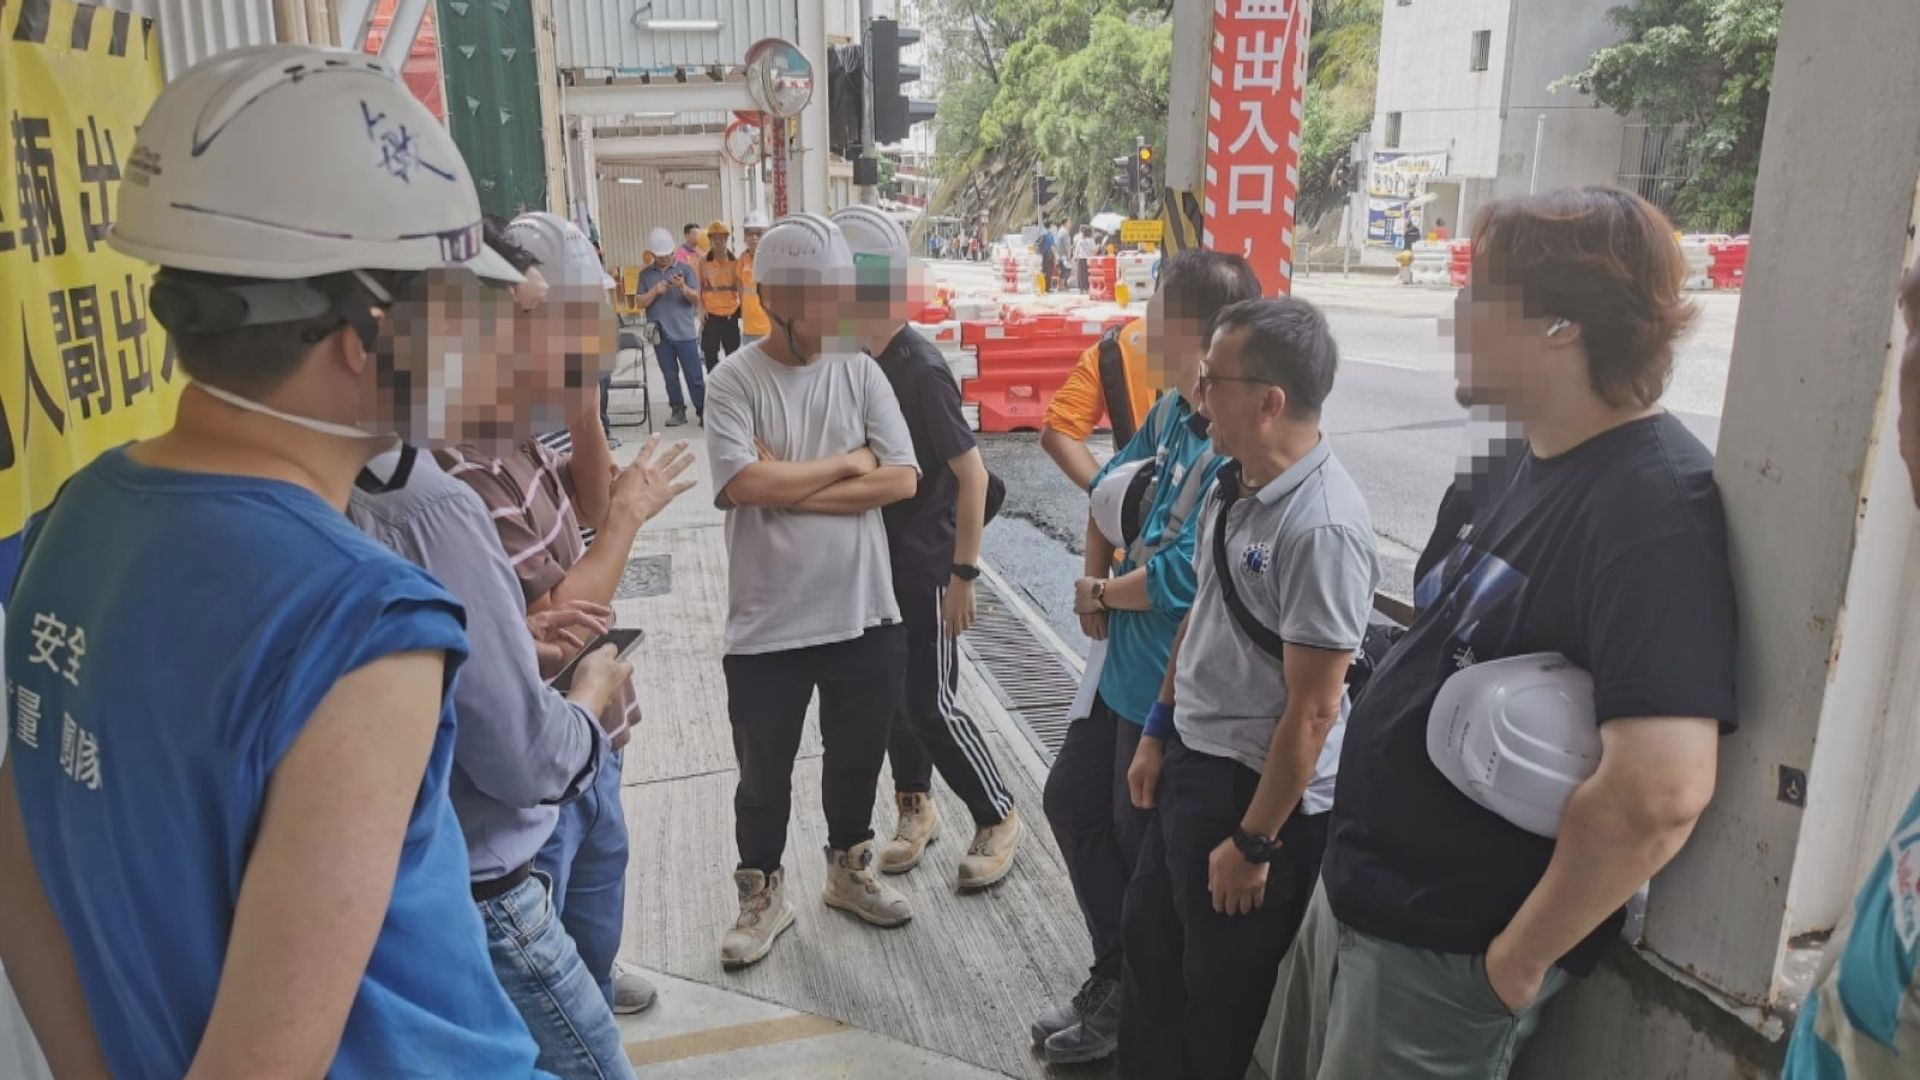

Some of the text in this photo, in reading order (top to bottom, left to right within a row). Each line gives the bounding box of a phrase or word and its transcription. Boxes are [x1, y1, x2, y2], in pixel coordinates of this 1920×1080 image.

[0, 110, 142, 262] 輛出
[0, 273, 174, 470] 人閘出
[28, 612, 86, 686] 安全
